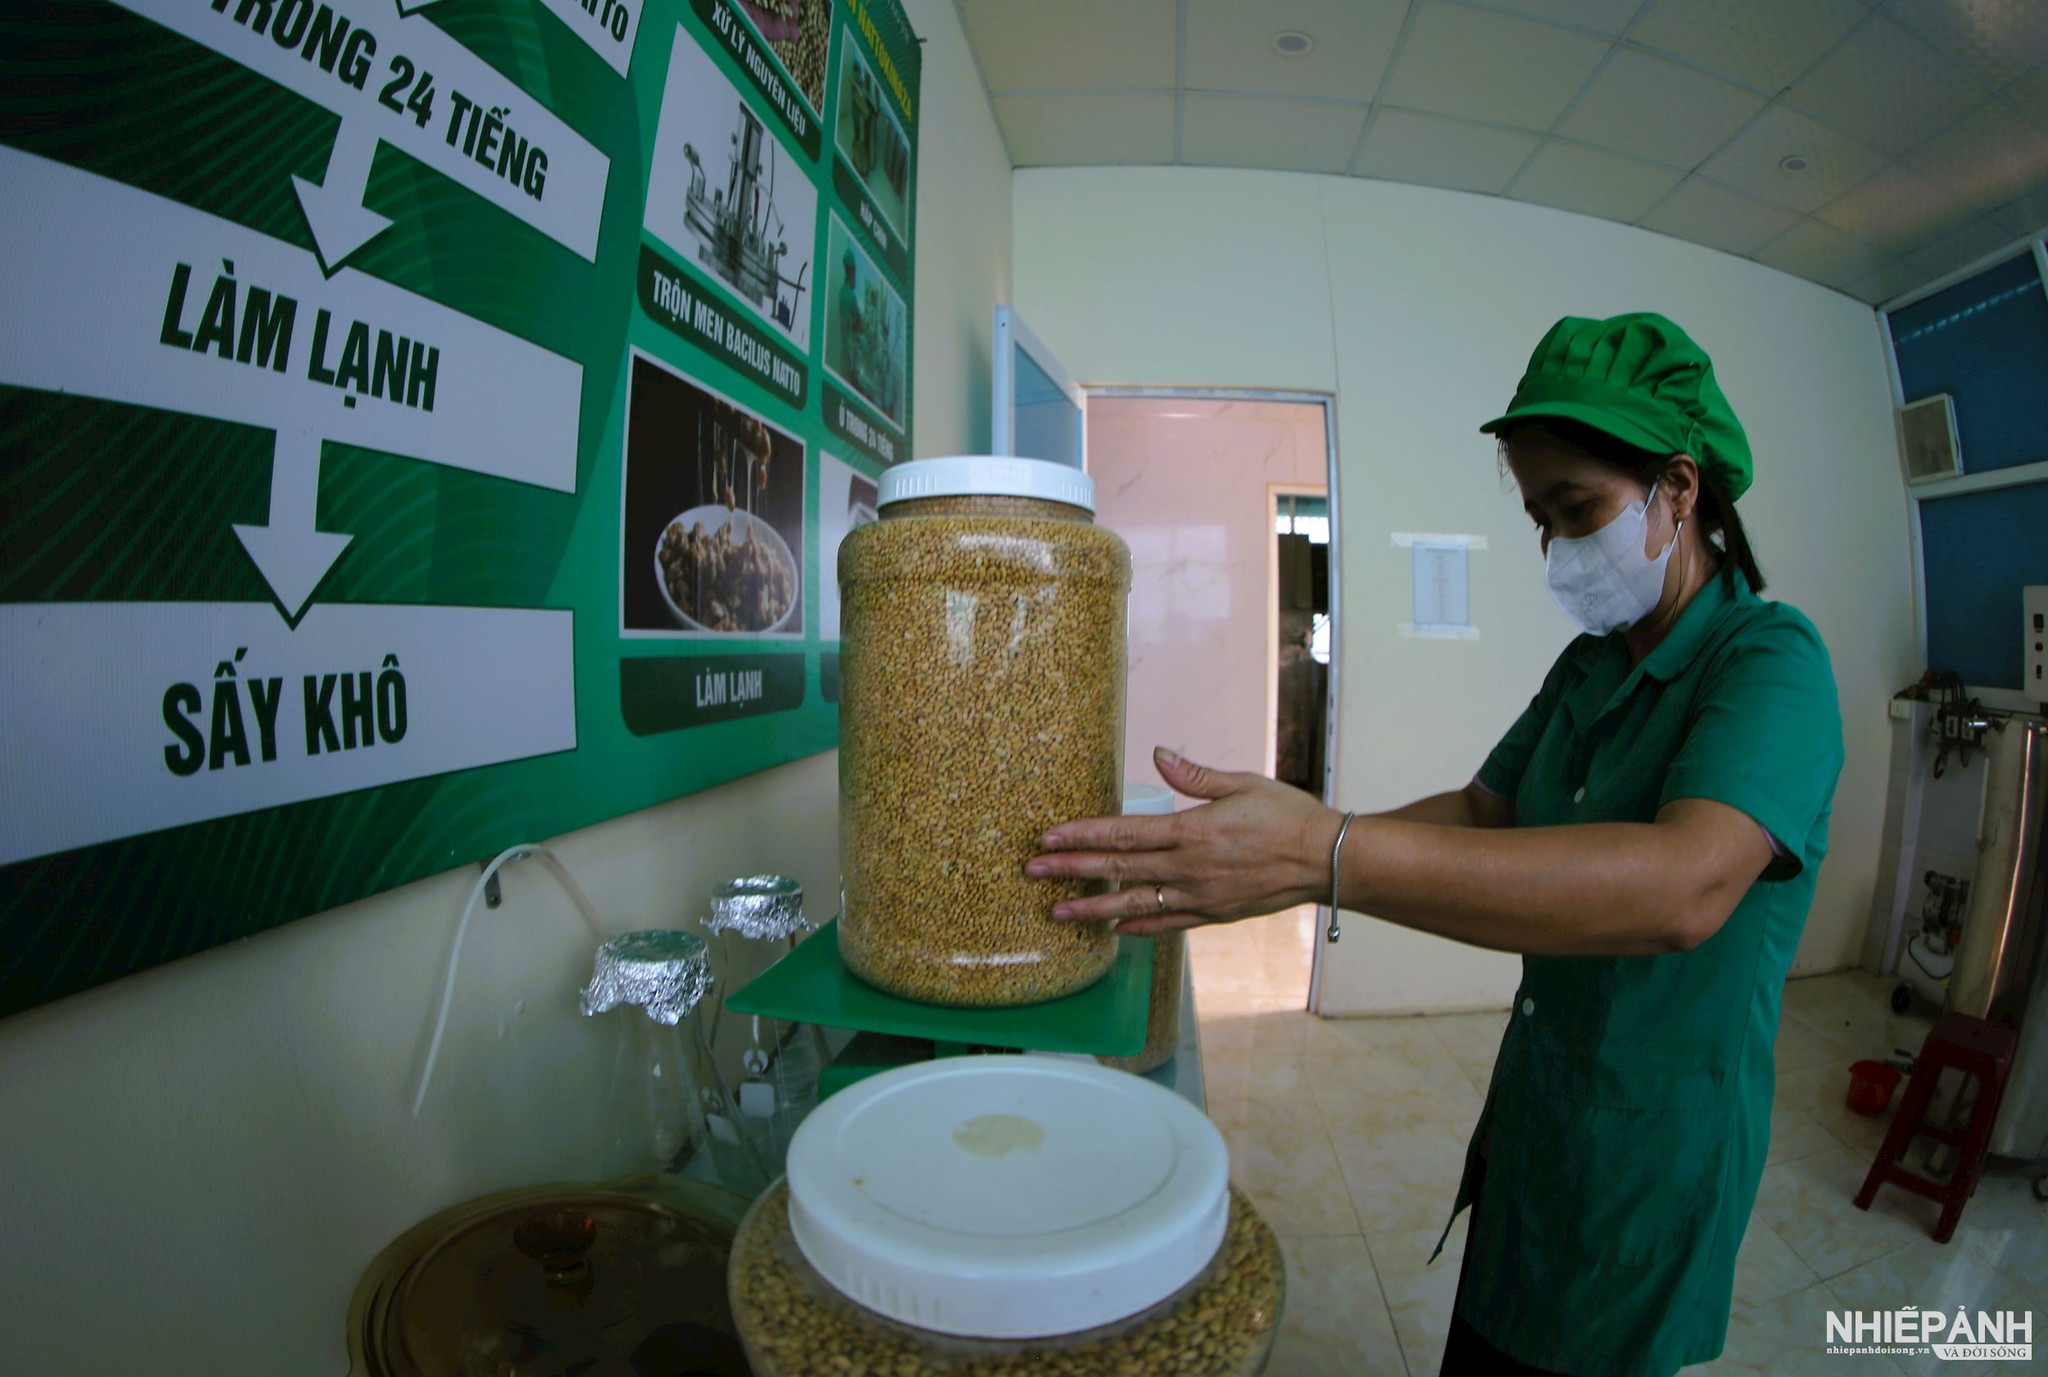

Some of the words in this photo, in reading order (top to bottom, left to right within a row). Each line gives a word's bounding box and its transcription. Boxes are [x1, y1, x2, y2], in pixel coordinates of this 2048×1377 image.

[211, 0, 377, 91] RONG
[378, 54, 435, 129] 24
[446, 89, 548, 202] TIẾNG
[712, 1, 732, 35] XỬ
[730, 23, 746, 54] LÝ
[746, 43, 786, 110] NGUYÊN
[786, 97, 806, 136] LIỆU
[159, 258, 298, 374] LÀM
[308, 308, 440, 413] LẠNH
[653, 270, 692, 323] TRỘN
[694, 299, 724, 345] MEN
[725, 322, 771, 376] BACILUS
[772, 355, 801, 397] NATTO
[162, 647, 283, 777] SẤY
[303, 653, 408, 756] KHÔ
[696, 666, 726, 708] LÀM
[730, 669, 763, 708] LẠNH
